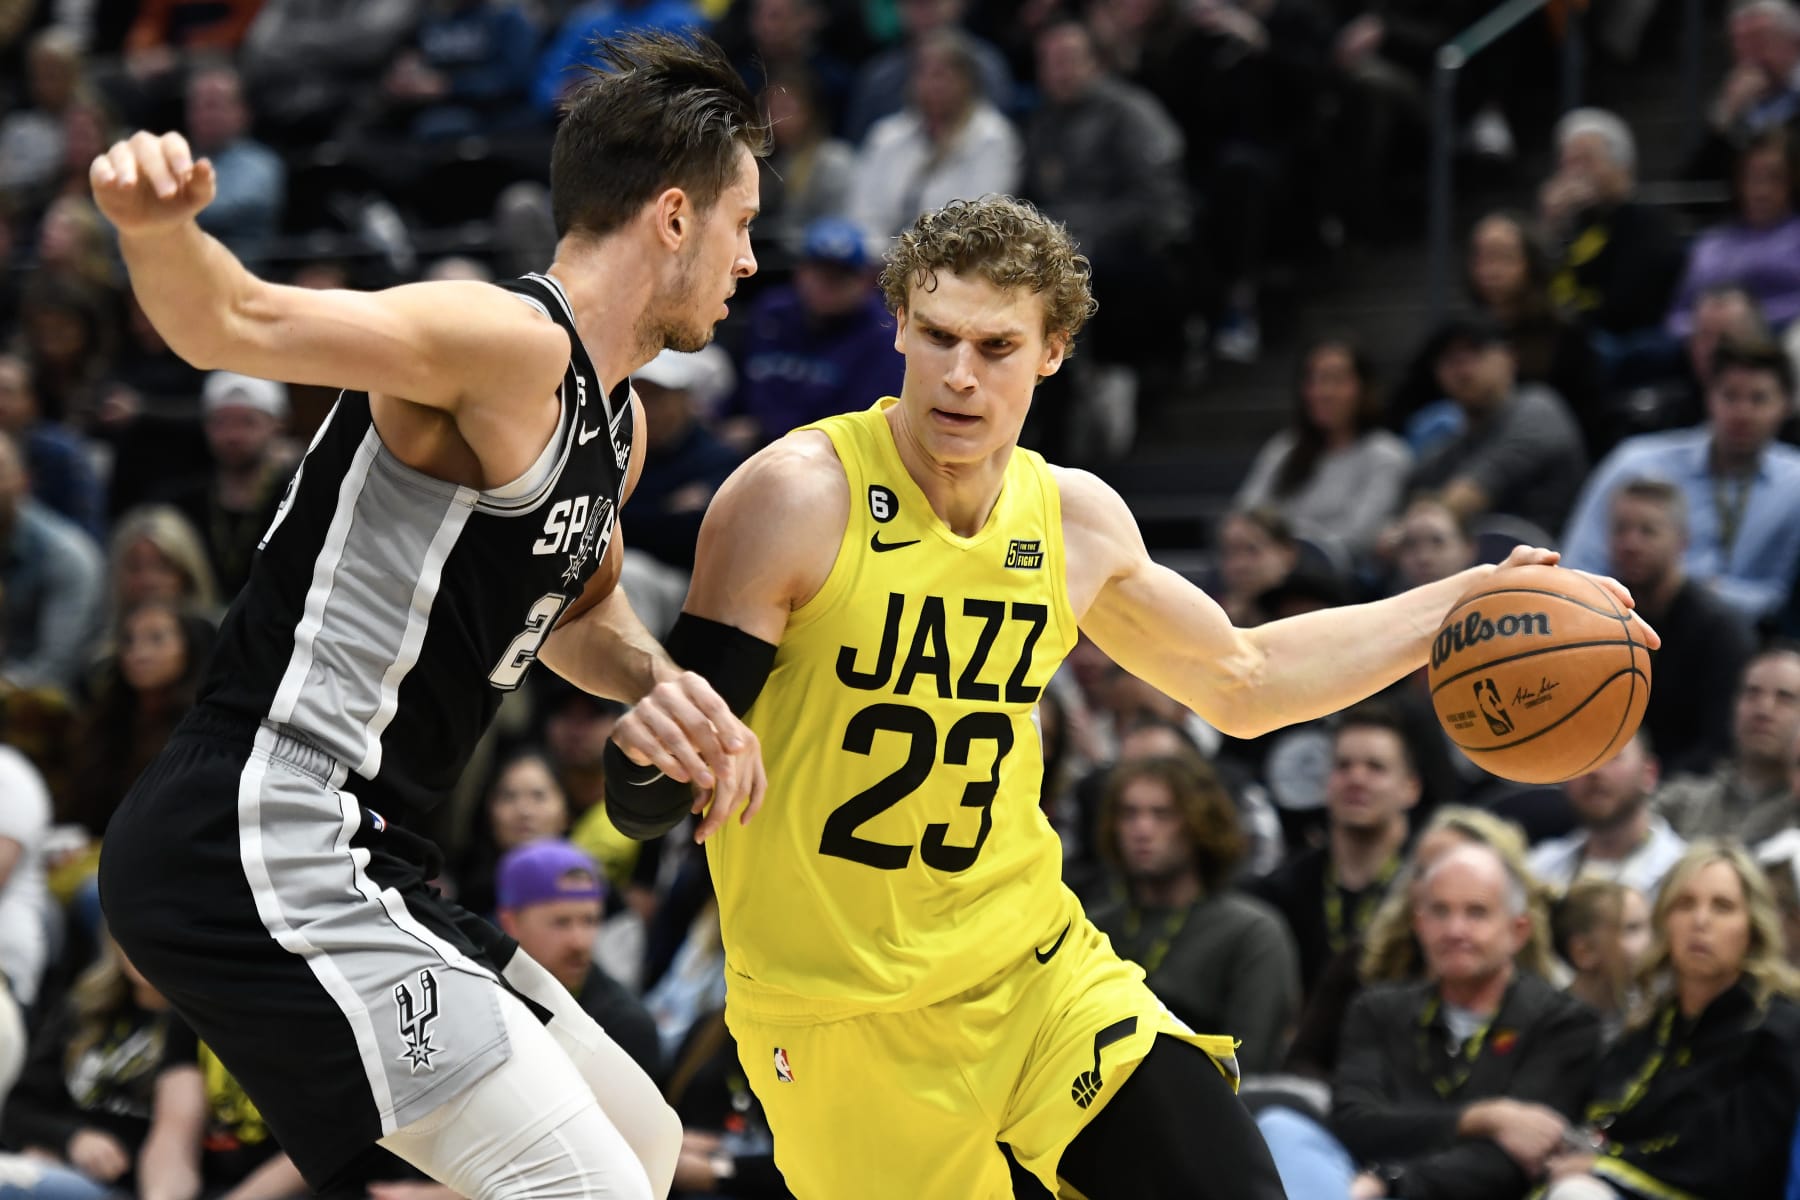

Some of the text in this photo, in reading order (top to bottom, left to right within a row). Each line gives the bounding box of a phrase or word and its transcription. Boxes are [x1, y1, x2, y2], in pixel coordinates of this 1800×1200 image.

[871, 490, 889, 519] 6
[1007, 542, 1018, 566] 5
[1017, 555, 1040, 567] FIGHT
[836, 592, 1048, 703] JAZZ
[1432, 611, 1552, 671] Wilson
[818, 702, 1015, 873] 23
